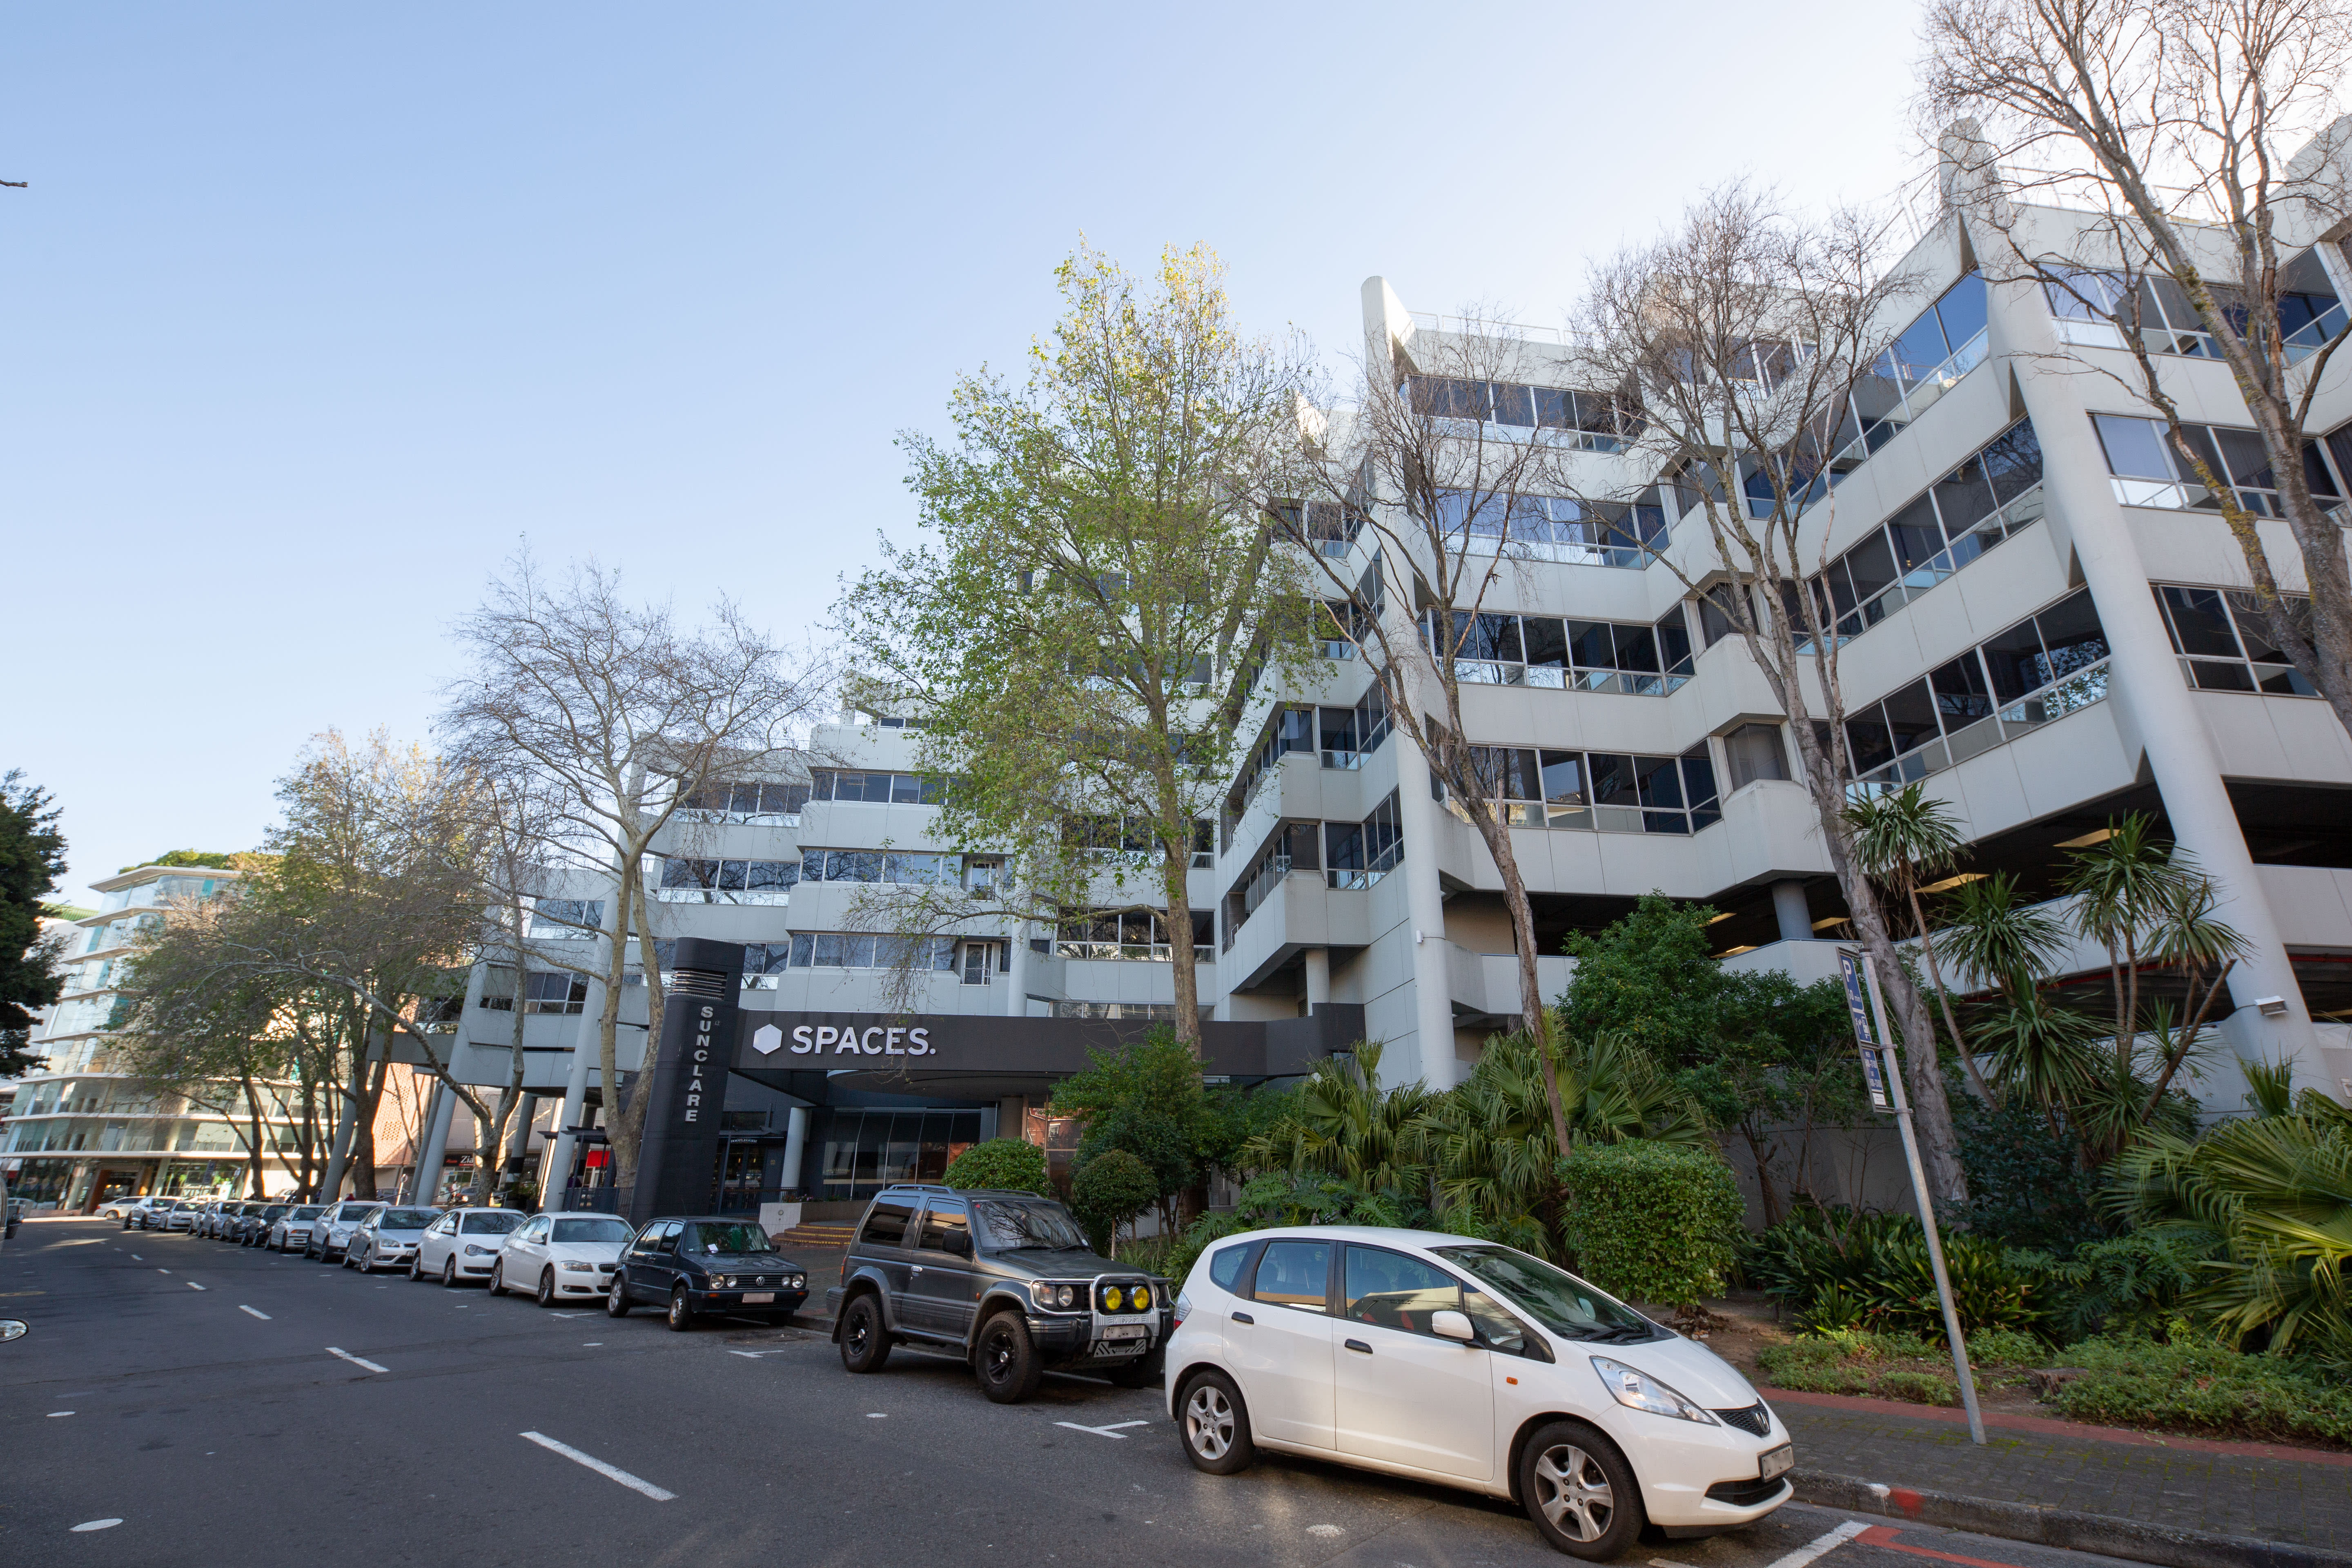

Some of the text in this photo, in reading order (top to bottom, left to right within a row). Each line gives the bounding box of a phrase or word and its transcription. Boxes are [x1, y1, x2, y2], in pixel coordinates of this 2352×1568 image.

[1842, 959, 1852, 982] P
[790, 1025, 936, 1055] SPACES.
[685, 1006, 714, 1122] SUNCLARE
[1113, 1316, 1142, 1324] MITSUBISHI
